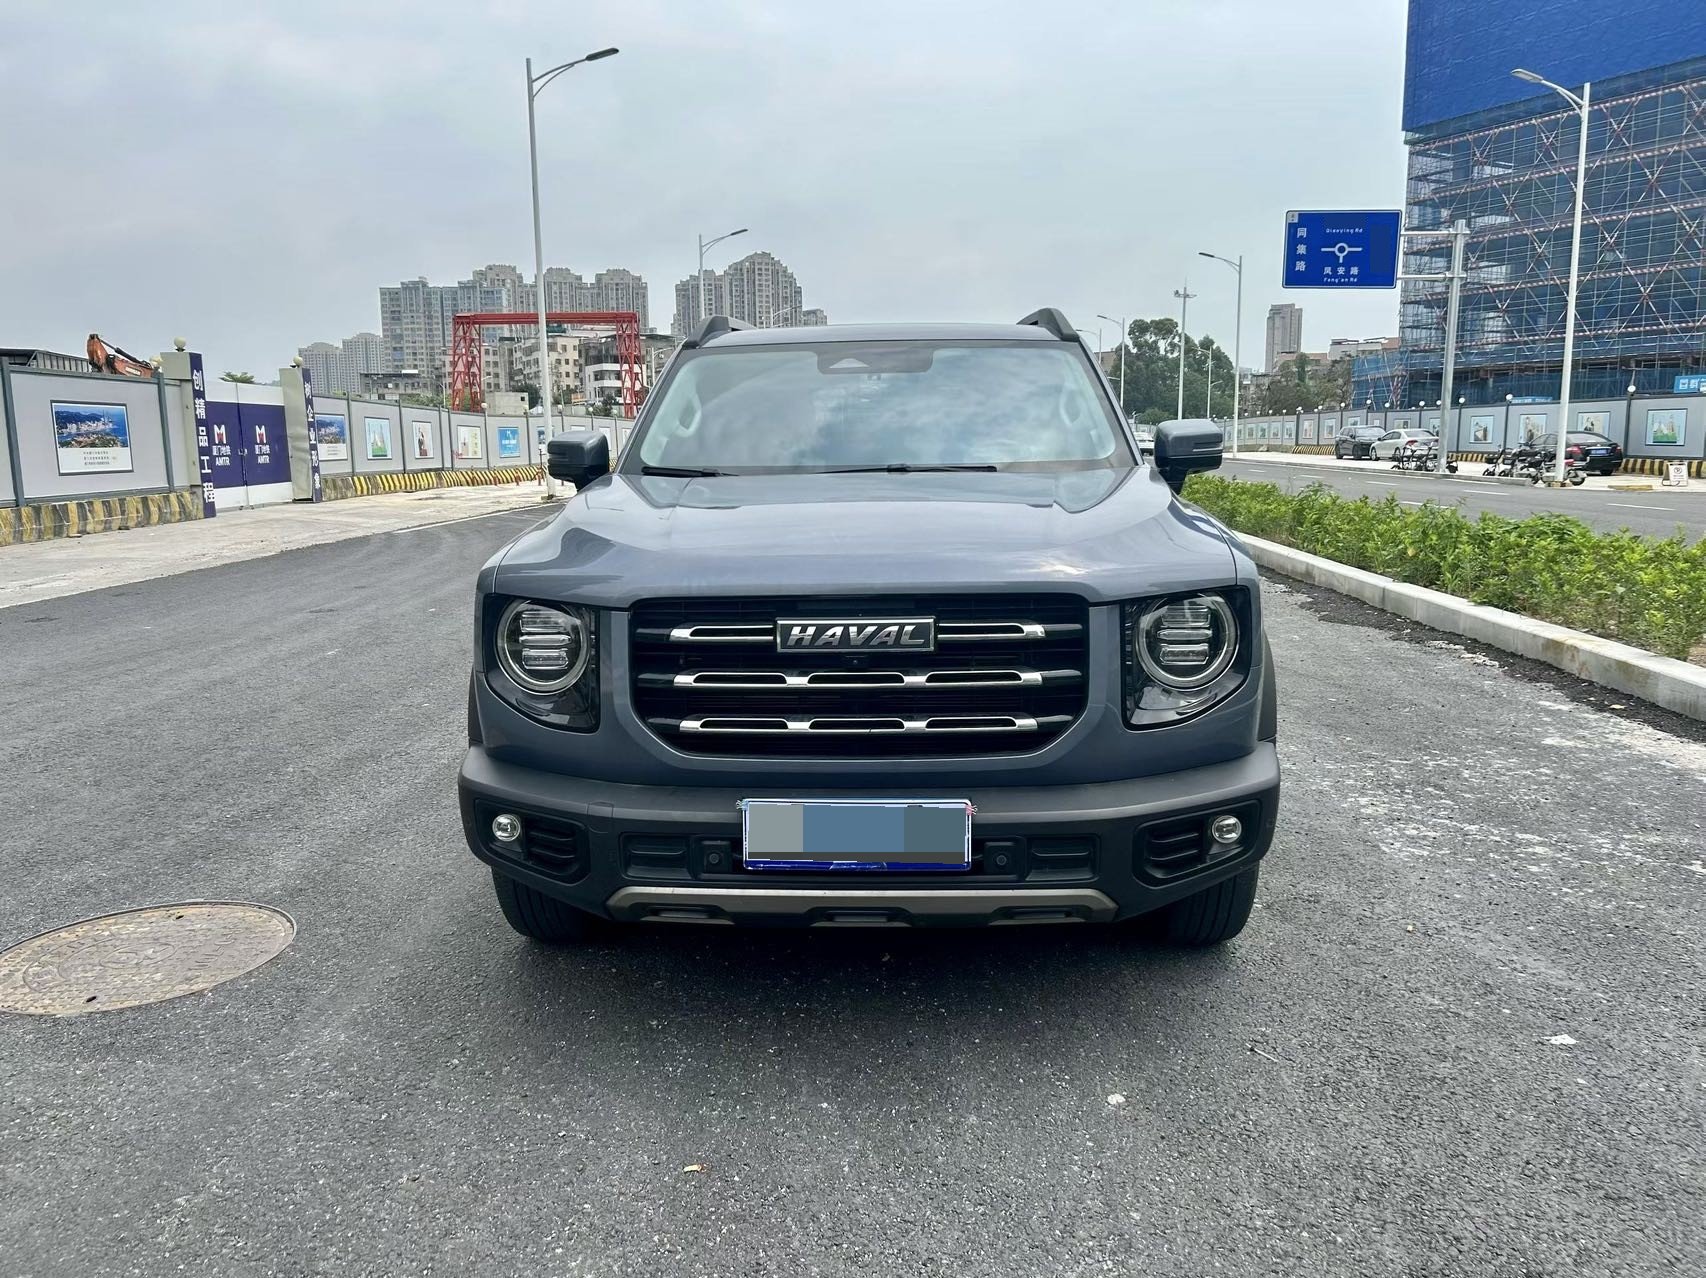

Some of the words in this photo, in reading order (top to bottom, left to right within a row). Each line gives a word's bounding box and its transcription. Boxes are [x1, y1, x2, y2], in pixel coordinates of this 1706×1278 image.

[1294, 227, 1307, 272] 同集路
[192, 369, 215, 503] 创精品工程
[304, 381, 320, 490] 树企业形象
[215, 456, 231, 466] AMTR
[257, 455, 270, 464] AMTR
[786, 625, 925, 646] HAVAL
